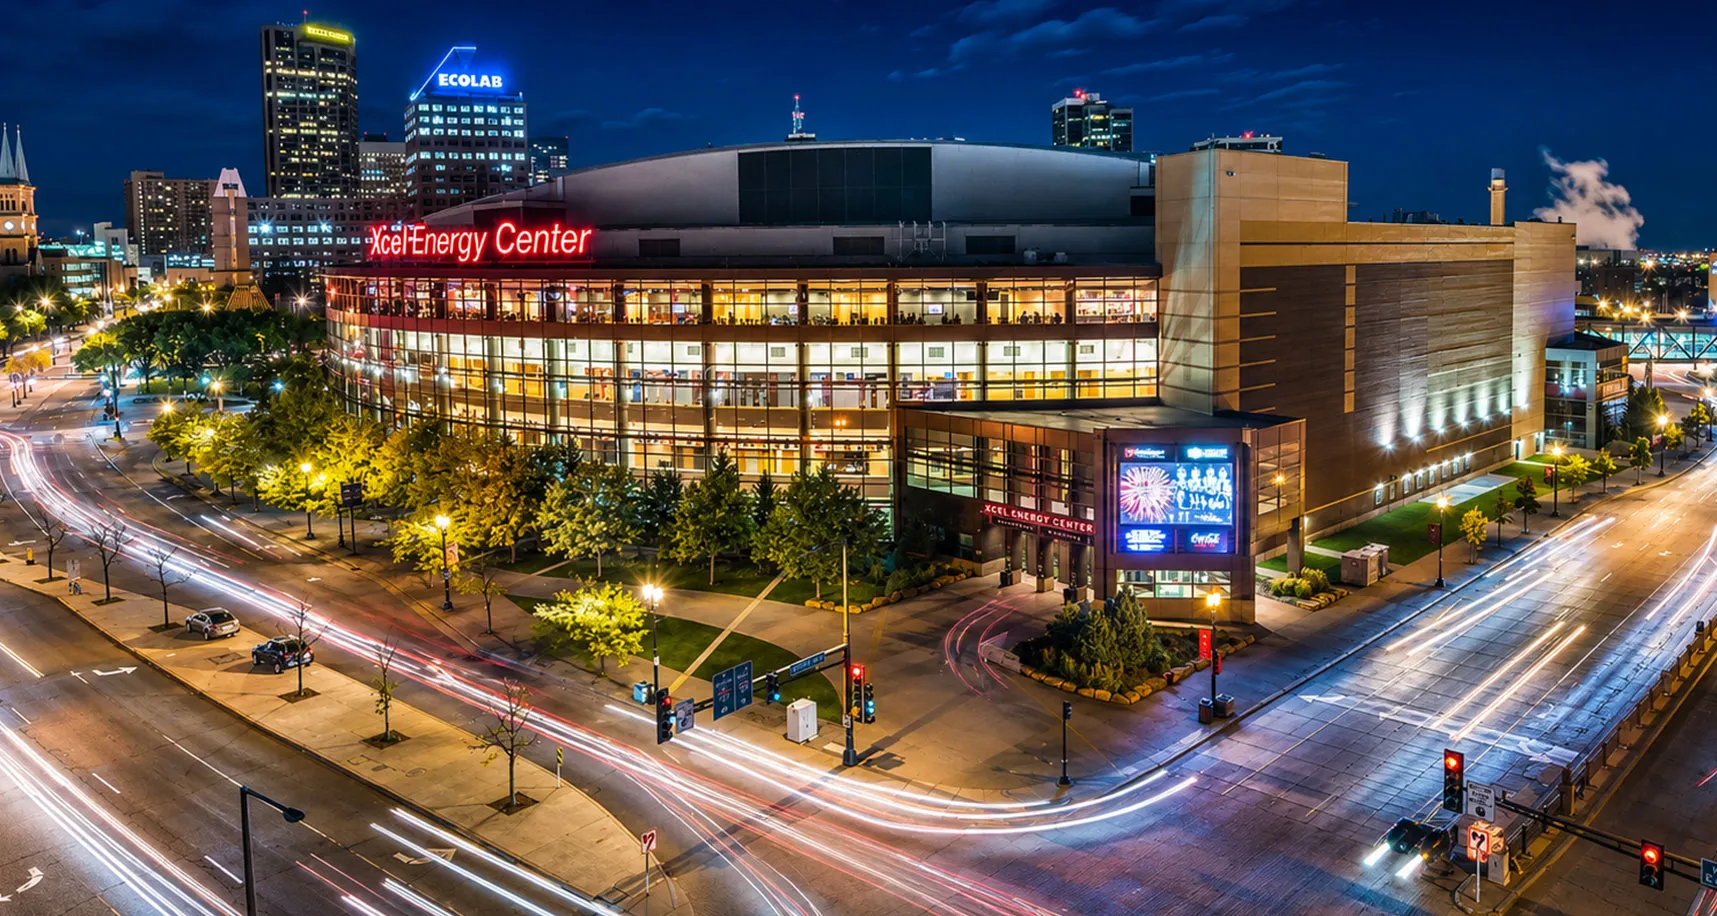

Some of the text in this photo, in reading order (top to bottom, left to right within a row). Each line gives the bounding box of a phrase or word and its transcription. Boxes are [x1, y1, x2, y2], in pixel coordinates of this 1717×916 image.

[438, 73, 503, 88] ECOLAB
[370, 222, 593, 263] Xcel Energy Center
[984, 504, 1094, 532] XCEL ENERGY CENTER
